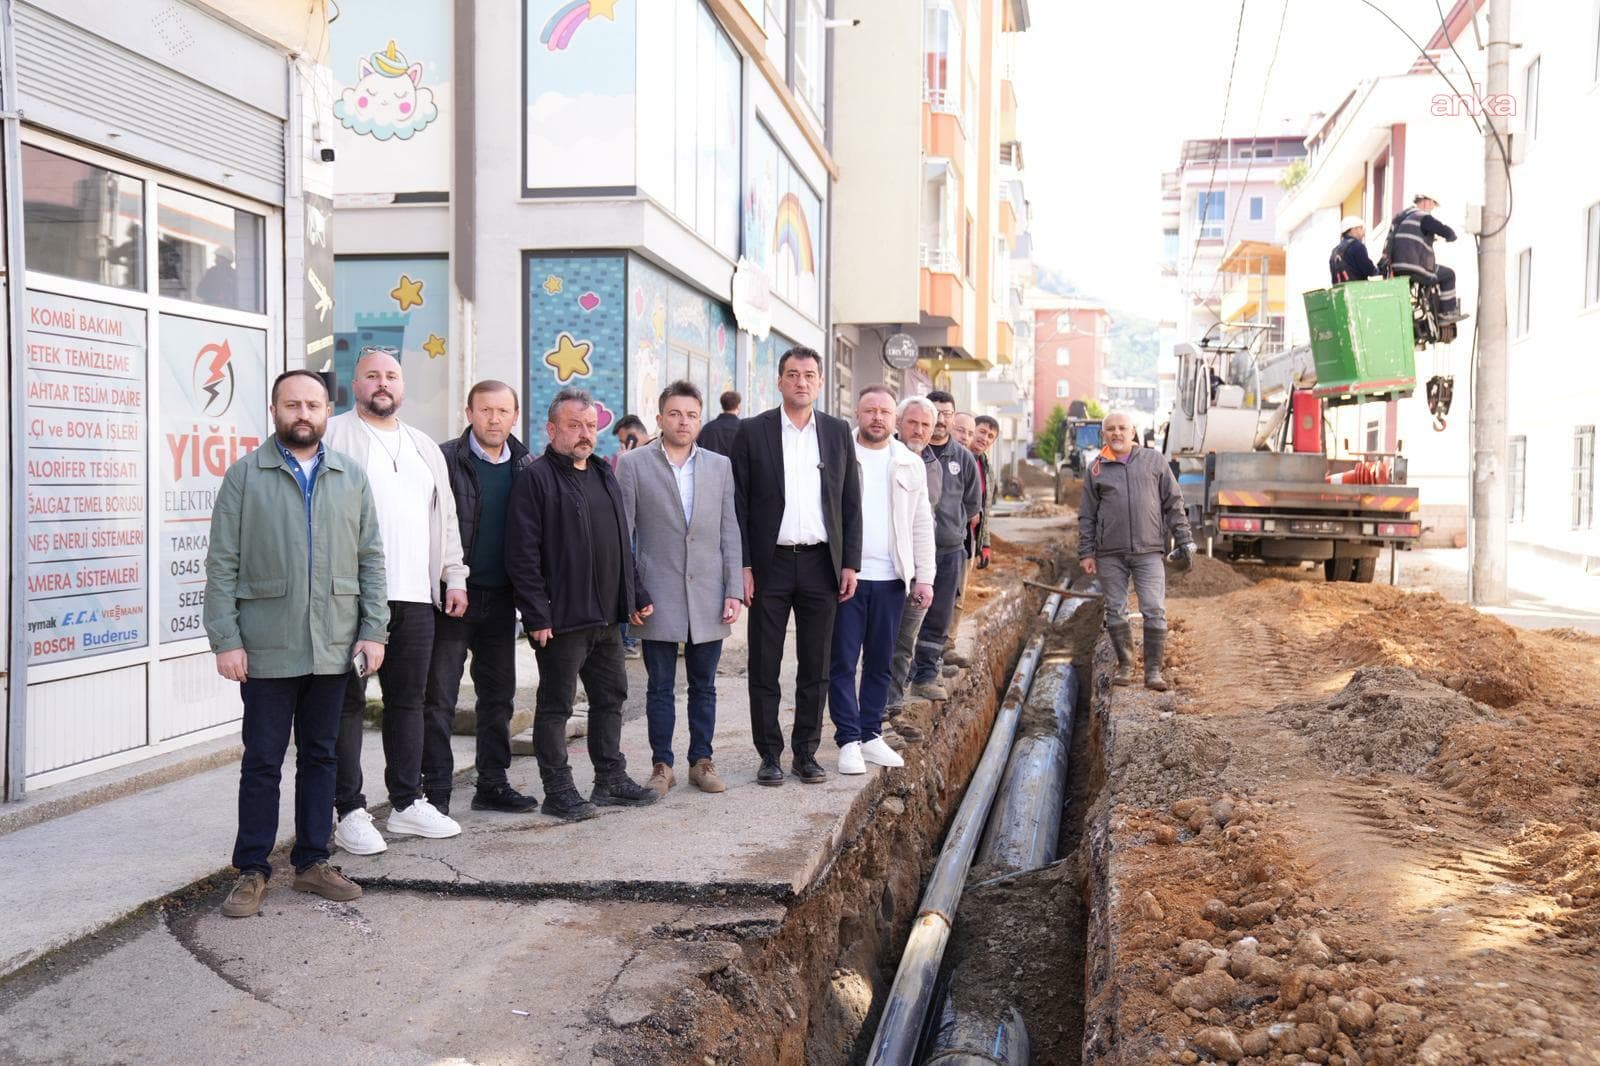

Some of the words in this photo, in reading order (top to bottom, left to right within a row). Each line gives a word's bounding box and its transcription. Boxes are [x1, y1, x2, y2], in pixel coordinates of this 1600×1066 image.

[31, 307, 75, 330] KOMBİ
[80, 315, 122, 337] BAKIMI
[65, 347, 130, 372] TEMİZLEME
[27, 382, 69, 401] AHTAR
[73, 383, 108, 404] TESLİM
[112, 386, 141, 407] DAİRE
[49, 426, 63, 437] ve
[68, 421, 102, 439] BOYA
[107, 419, 138, 443] İŞLERİ
[166, 424, 260, 482] YİĞİT
[90, 457, 137, 478] TESİSATI
[74, 496, 103, 513] TEMEL
[106, 496, 144, 512] BORUSU
[54, 527, 88, 550] ENERJİ
[92, 525, 144, 548] SİSTEMLERİ
[171, 535, 209, 552] TARKA
[76, 562, 139, 588] SİSTEMLERİ
[171, 559, 200, 576] 0545
[171, 615, 200, 632] 0545
[34, 636, 76, 656] BOSCH
[83, 629, 138, 647] Buderus
